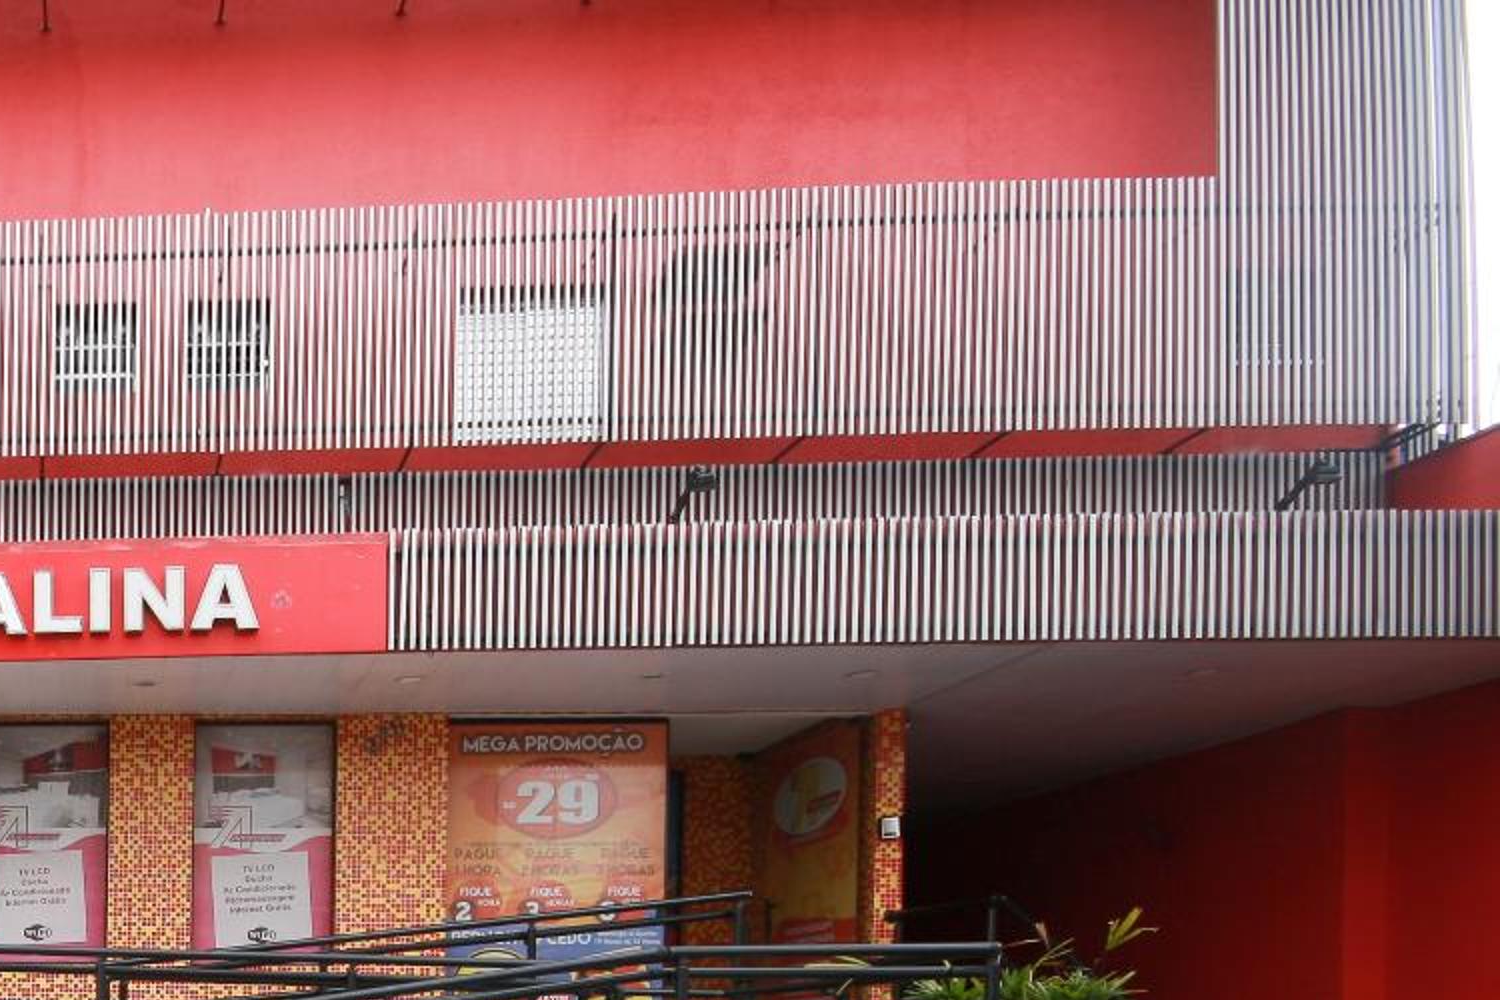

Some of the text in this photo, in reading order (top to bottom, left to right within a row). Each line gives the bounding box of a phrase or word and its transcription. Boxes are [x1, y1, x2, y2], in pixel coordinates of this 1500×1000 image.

[462, 728, 644, 757] MEGA PROMOÇÃO
[515, 779, 600, 825] 29
[454, 901, 474, 922] 2
